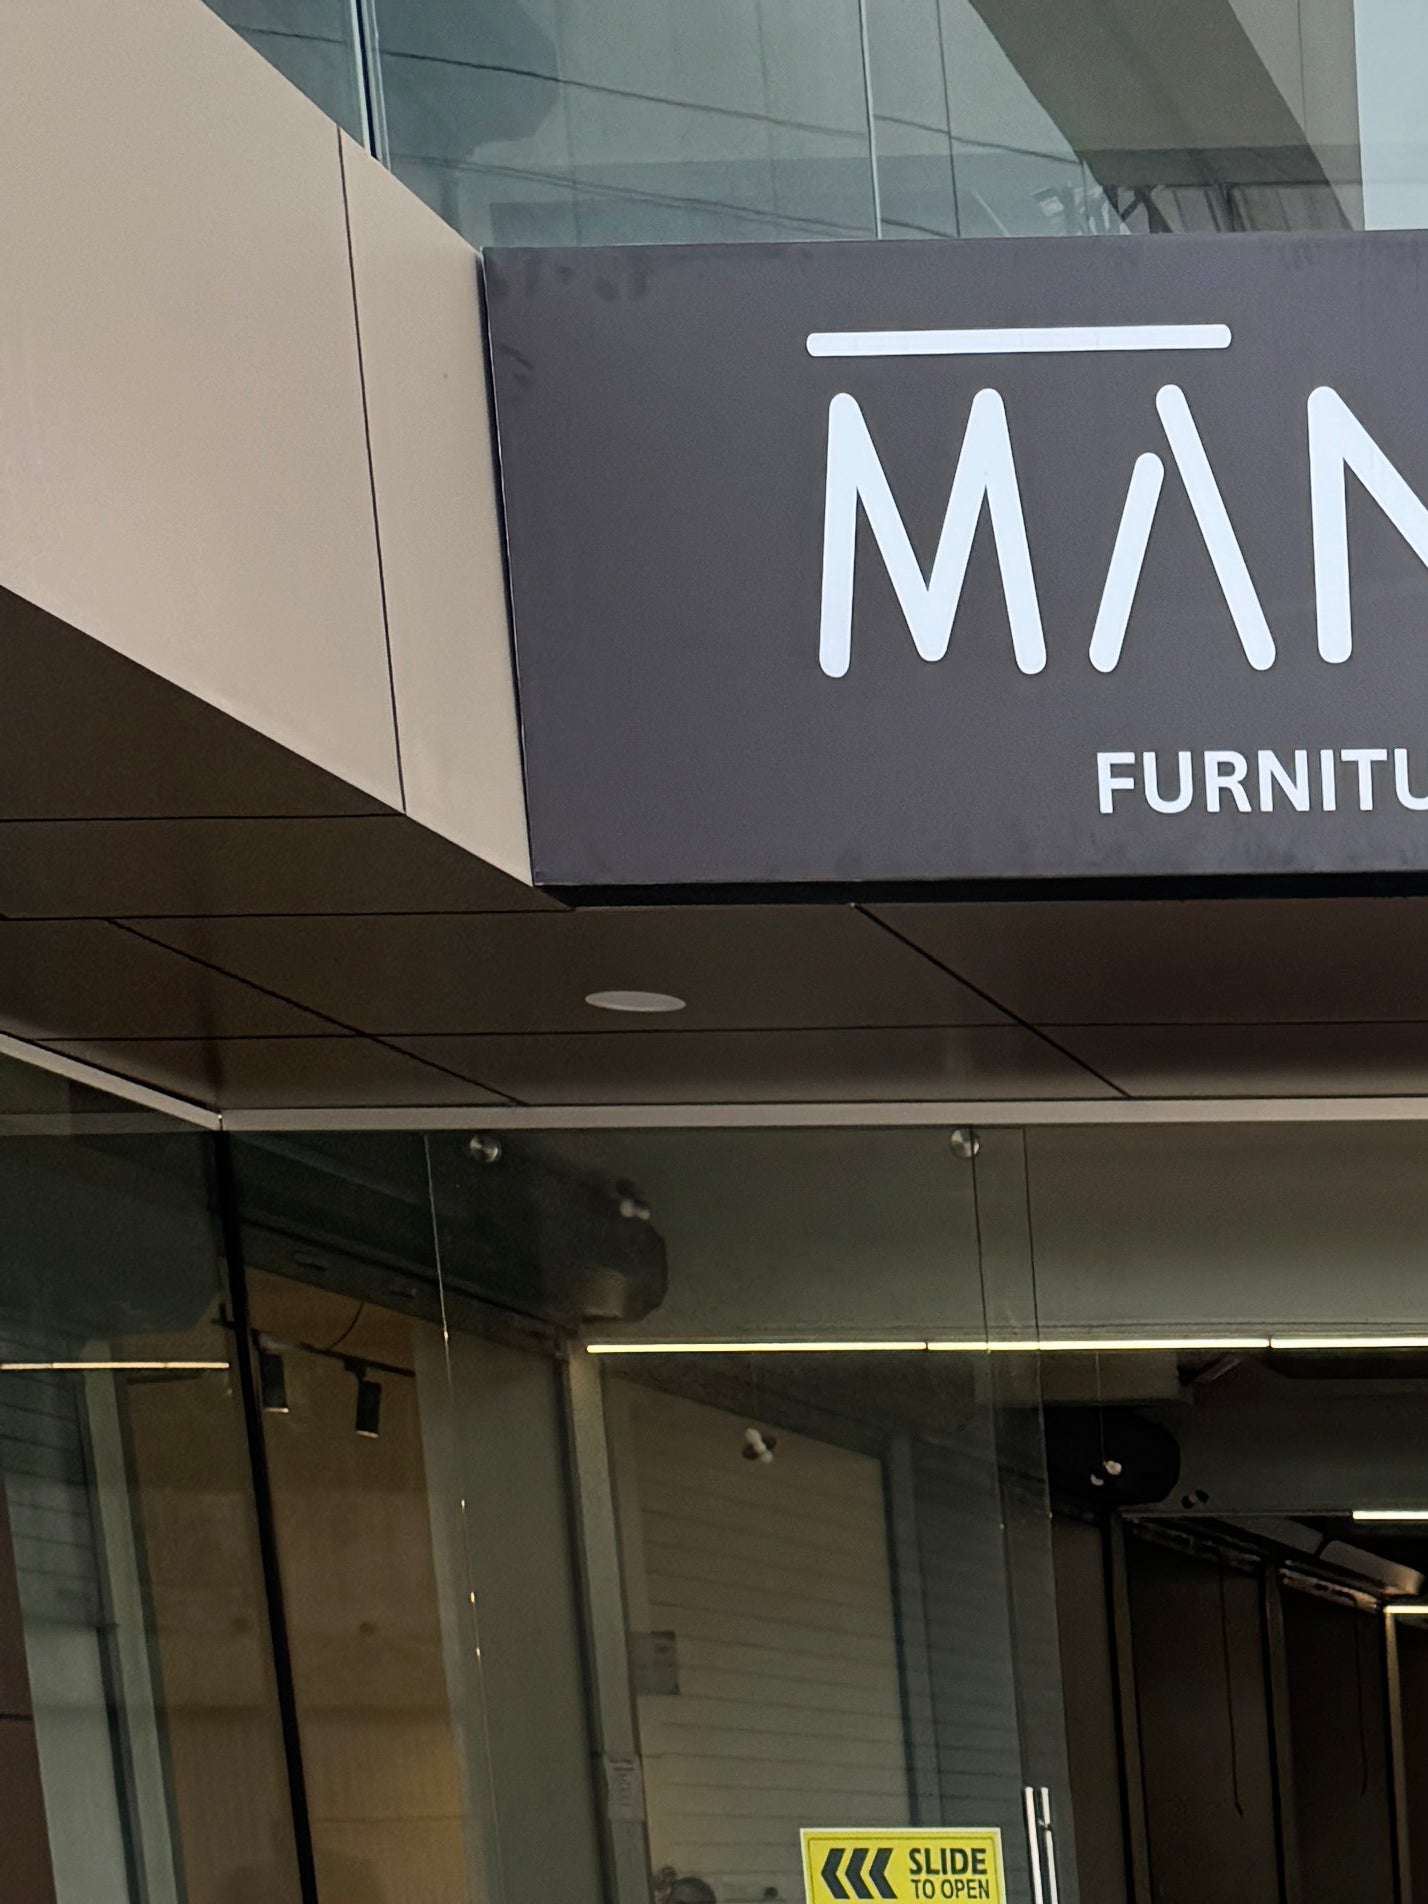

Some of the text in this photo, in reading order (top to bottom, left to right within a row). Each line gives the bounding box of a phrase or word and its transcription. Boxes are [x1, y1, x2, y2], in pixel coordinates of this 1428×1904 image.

[908, 1847, 988, 1876] SLIDE
[910, 1878, 990, 1900] TO OPEN
